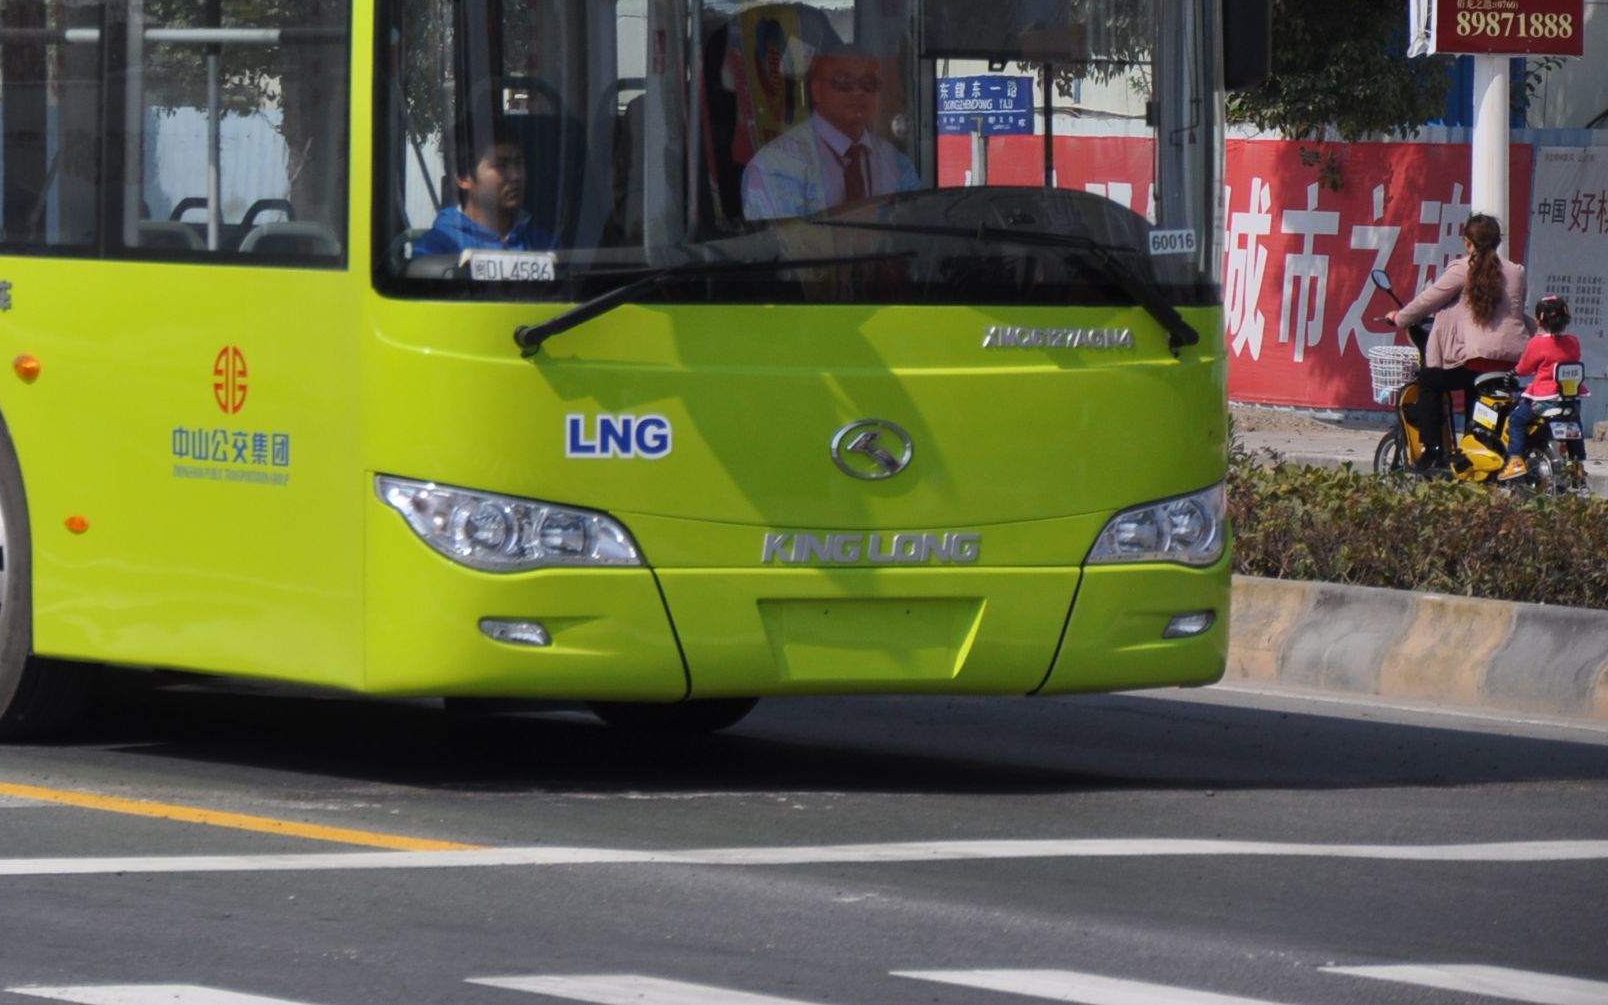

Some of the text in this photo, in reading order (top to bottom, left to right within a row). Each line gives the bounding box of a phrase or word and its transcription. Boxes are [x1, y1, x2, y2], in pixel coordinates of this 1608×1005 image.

[1456, 11, 1573, 39] 89871888
[1152, 233, 1194, 251] 60016
[172, 426, 290, 467] 中山公交集团
[568, 416, 671, 456] LNG
[761, 532, 982, 563] KING LONG
